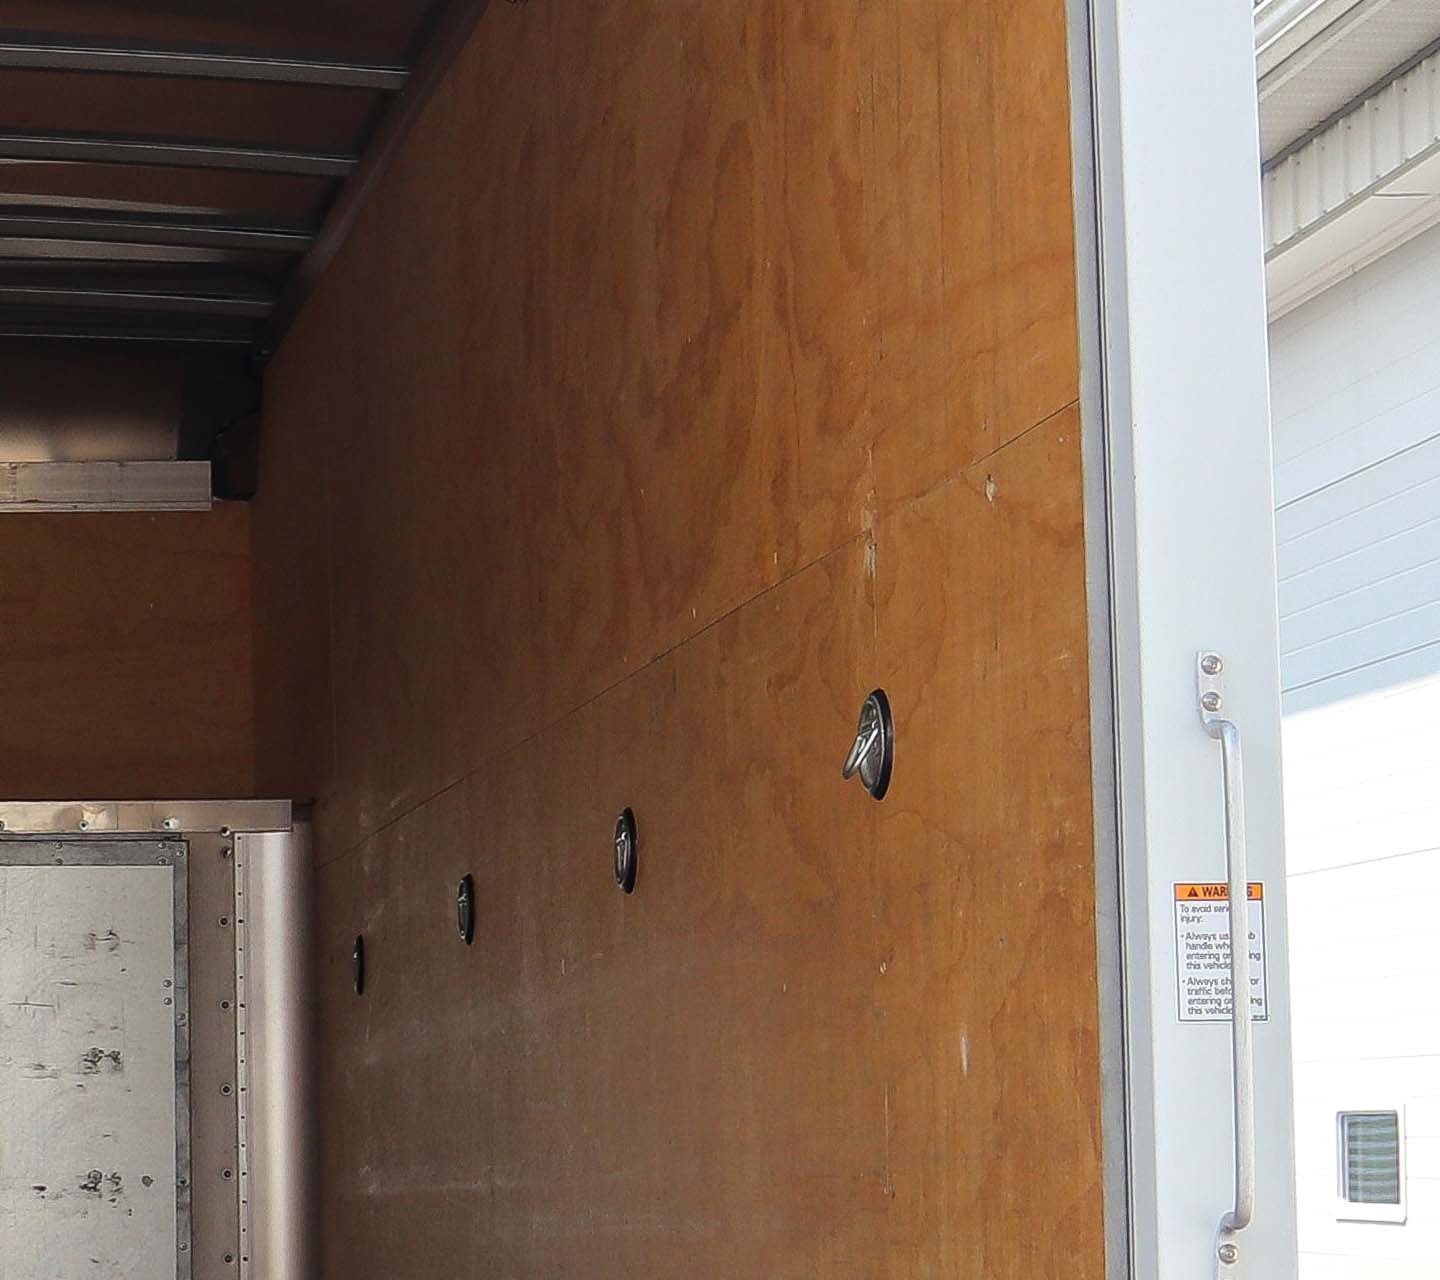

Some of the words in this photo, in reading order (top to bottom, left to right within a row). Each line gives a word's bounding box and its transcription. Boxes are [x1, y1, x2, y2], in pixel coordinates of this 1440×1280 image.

[1180, 904, 1190, 913] To
[1190, 904, 1212, 913] avoid
[1185, 931, 1217, 942] Always
[1185, 941, 1214, 950] handle
[1186, 951, 1221, 962] entering
[1185, 961, 1201, 970] this
[1186, 977, 1218, 987] Always
[1186, 987, 1213, 996] traffic
[1187, 997, 1222, 1007] entering
[1187, 1007, 1203, 1015] this
